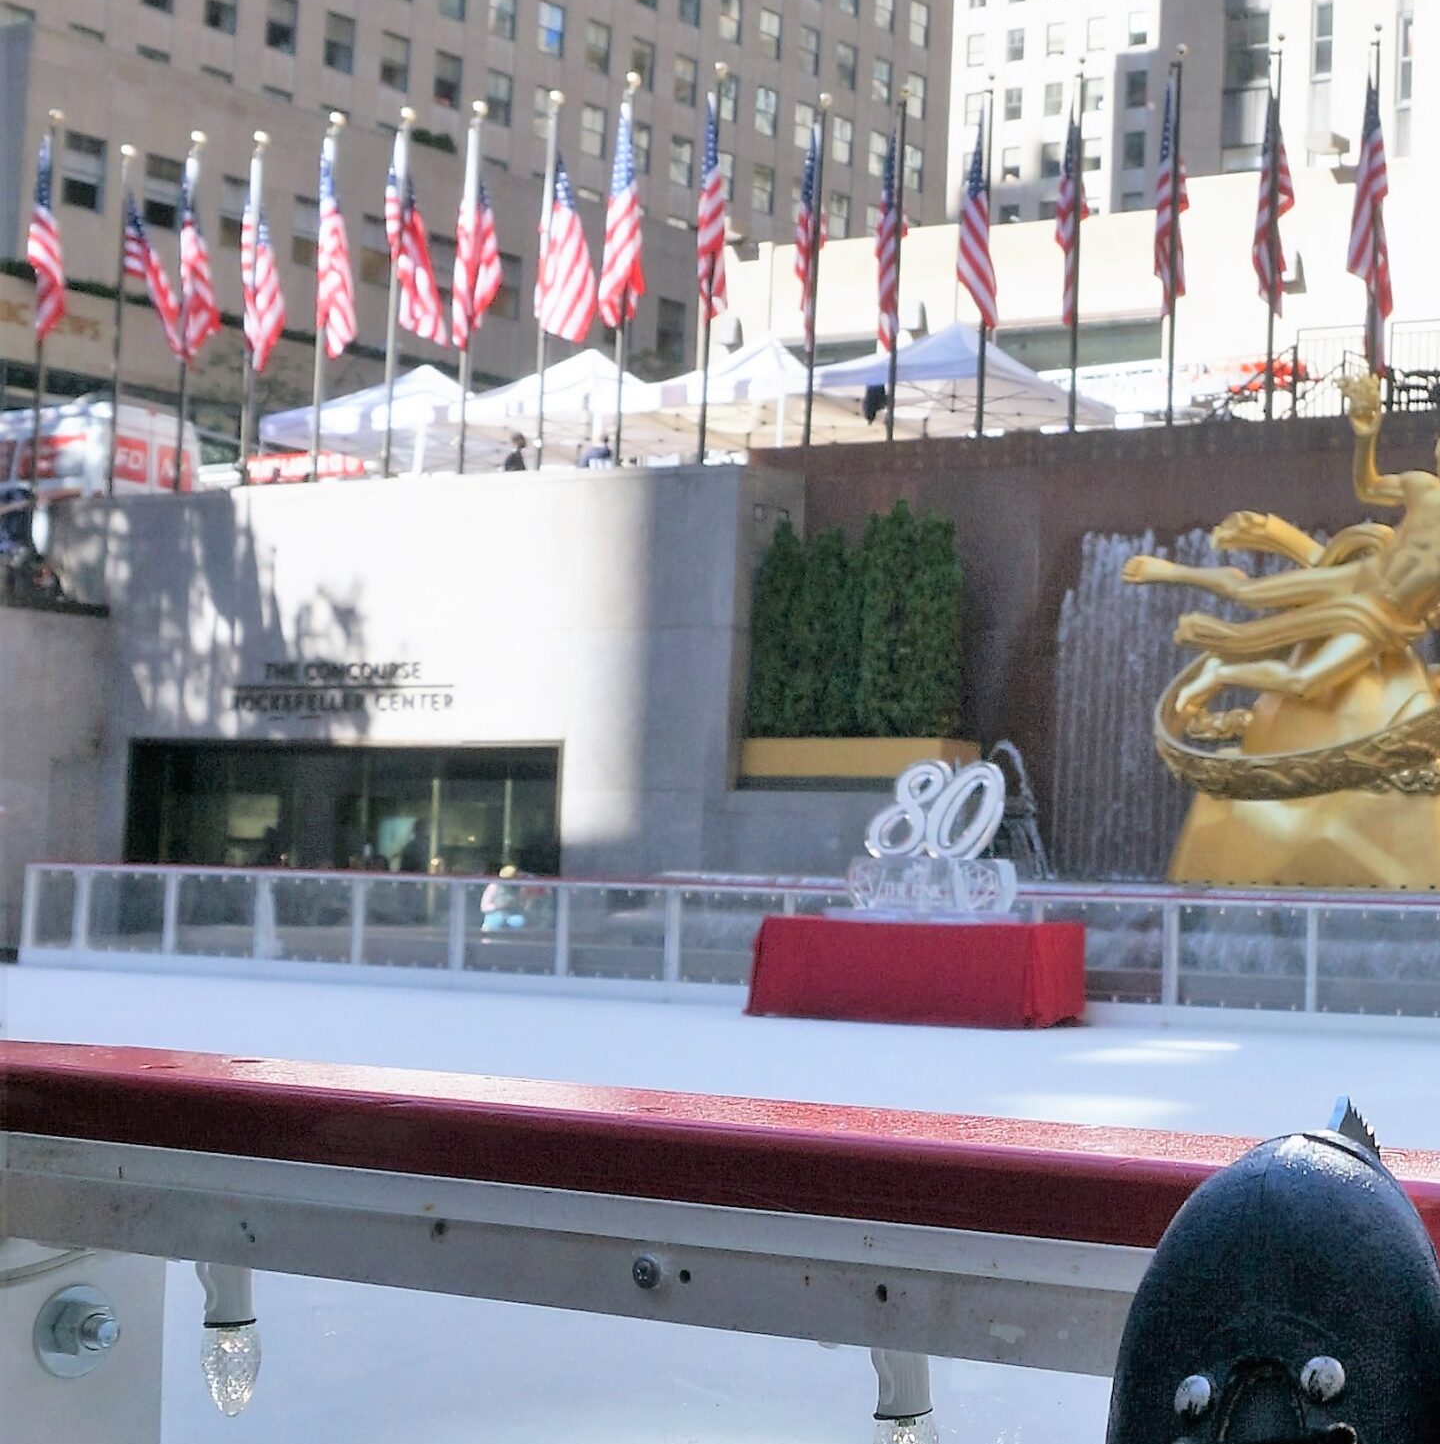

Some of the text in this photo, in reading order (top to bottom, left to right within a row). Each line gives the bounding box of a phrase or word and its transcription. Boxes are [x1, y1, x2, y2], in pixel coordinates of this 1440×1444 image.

[264, 662, 422, 681] THE CONCOURSE
[374, 694, 454, 712] CENTER
[864, 759, 1006, 859] 80
